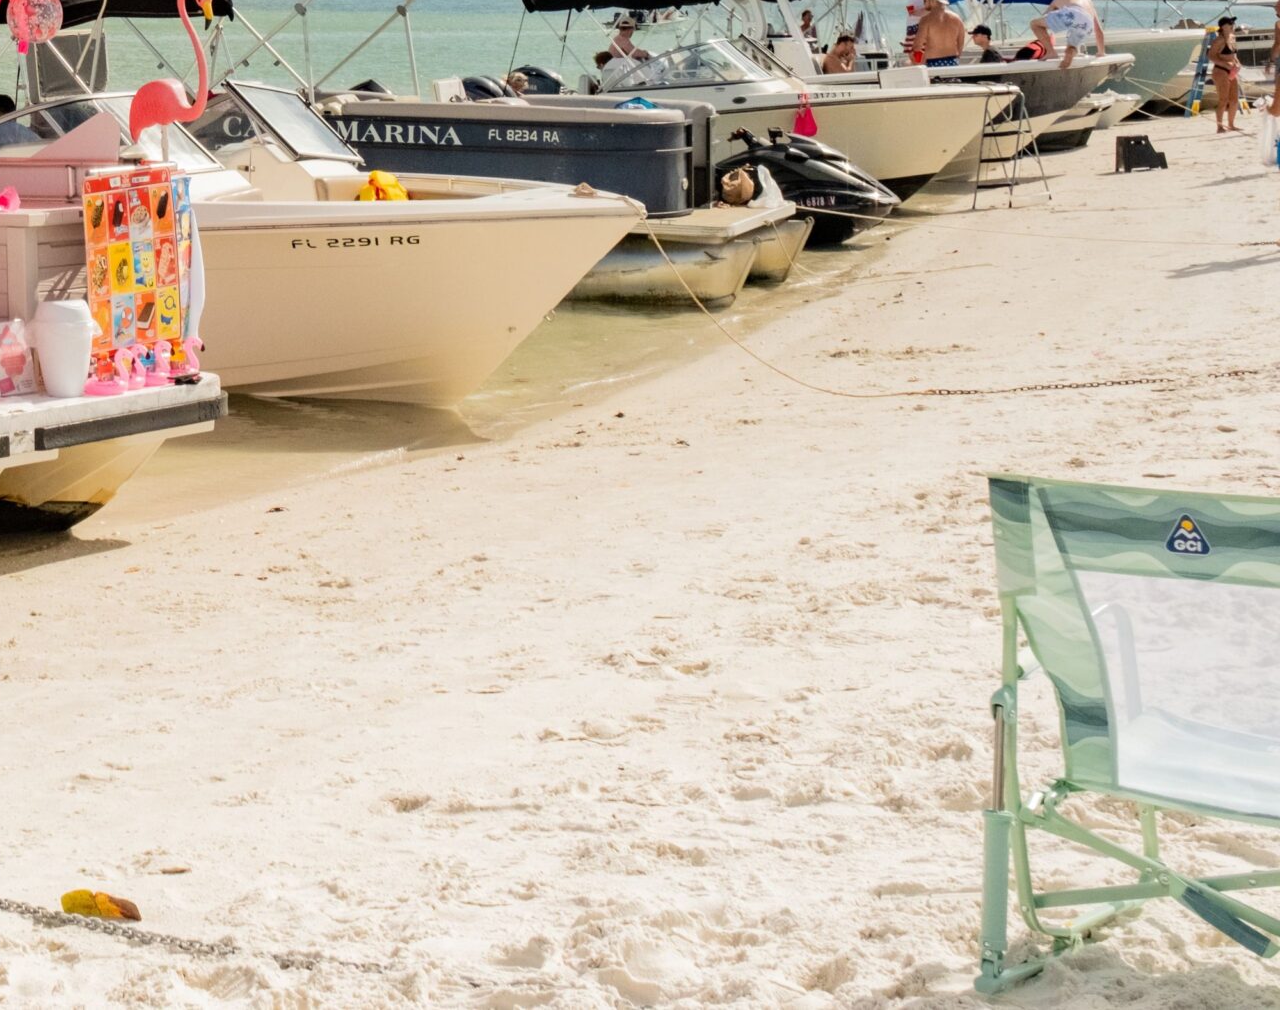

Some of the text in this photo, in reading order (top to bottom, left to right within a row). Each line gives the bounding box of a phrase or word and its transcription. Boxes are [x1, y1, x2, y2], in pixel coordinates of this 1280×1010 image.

[336, 121, 463, 146] MARINA
[488, 129, 559, 143] FL 8234 RA
[292, 235, 420, 249] FL 2291 RG
[1173, 539, 1202, 552] GCI
